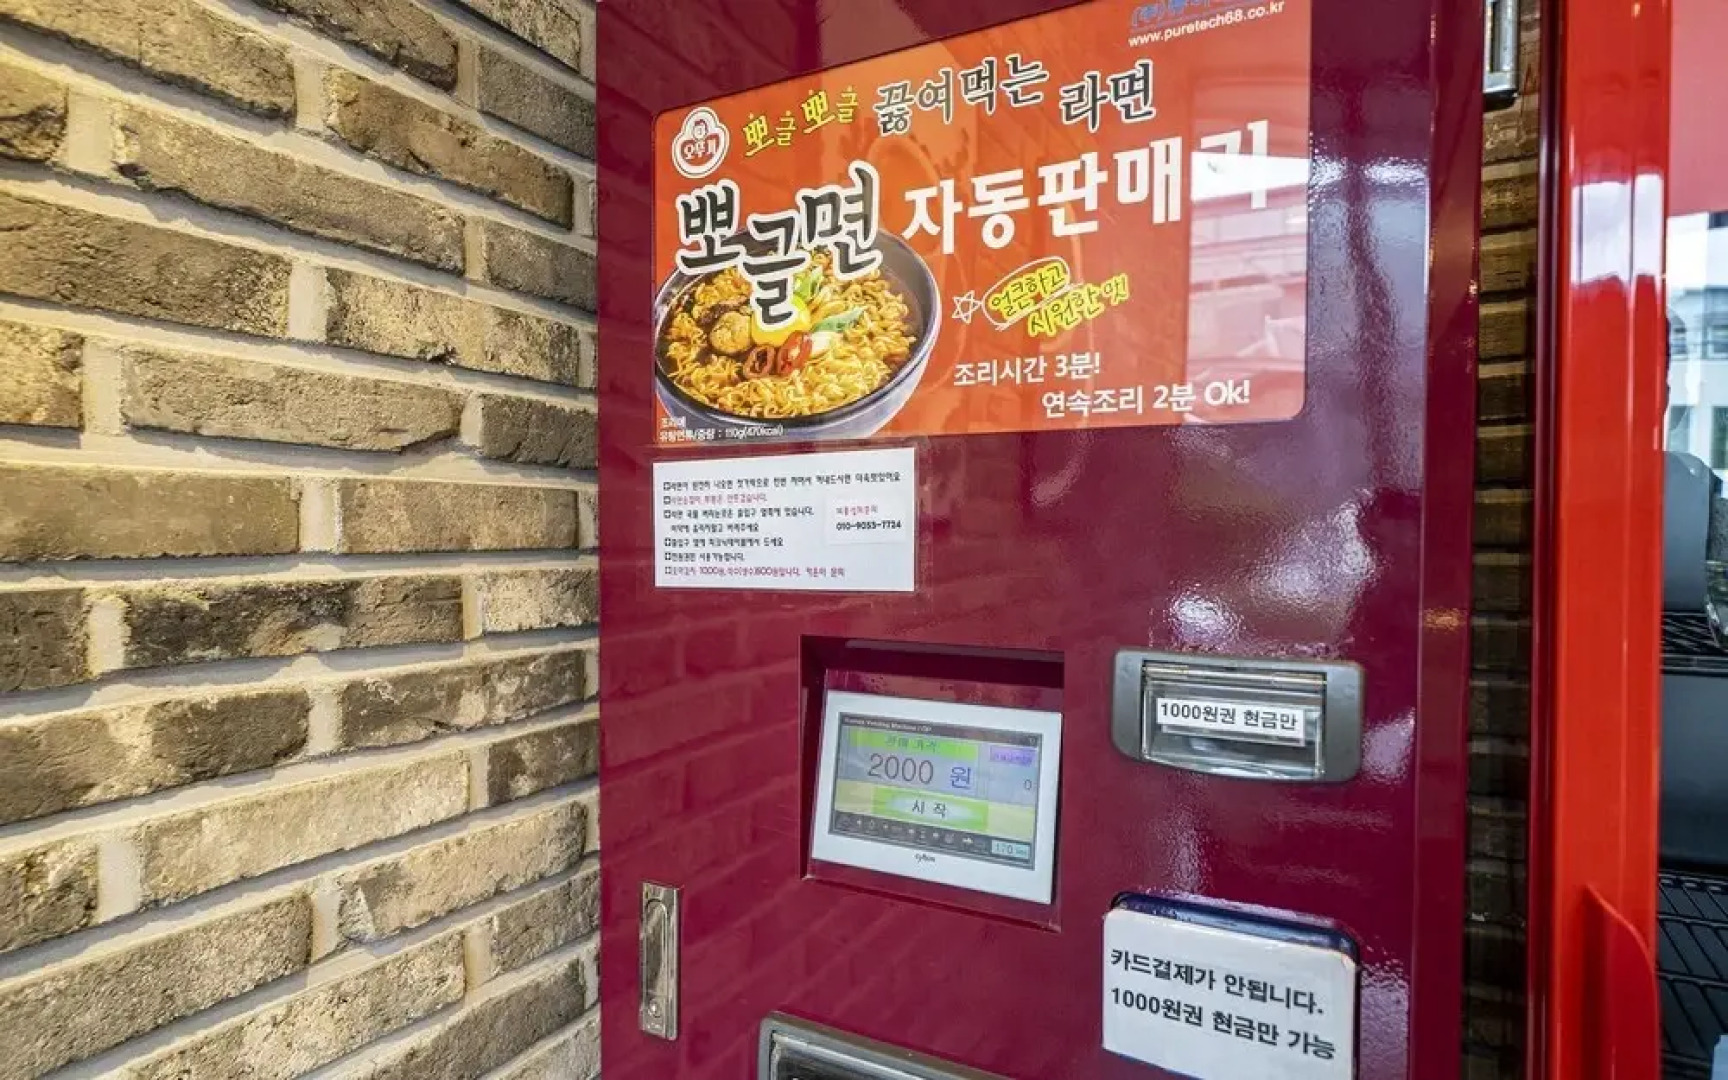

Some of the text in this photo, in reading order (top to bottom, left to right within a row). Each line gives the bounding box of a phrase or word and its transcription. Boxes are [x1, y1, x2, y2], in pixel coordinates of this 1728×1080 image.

[1128, 1, 1285, 47] www.puretech68.co.kr
[1060, 58, 1156, 133] 라면
[901, 119, 1270, 255] 자동판매기
[675, 159, 884, 332] 뽀글면
[989, 262, 1068, 319] 얼큰하고
[1028, 285, 1104, 337] 시원한
[953, 352, 1101, 387] 조리시간 3분!
[1042, 386, 1143, 419] 연속조리
[1153, 384, 1196, 412] 2분
[1161, 703, 1298, 731] 1000원권 현금만
[868, 753, 971, 790] 2000 원
[1024, 780, 1032, 790] 0
[1110, 950, 1323, 1015] 카드결제가 안됩니다.
[1111, 988, 1336, 1060] 1000원권 현금만 가능
